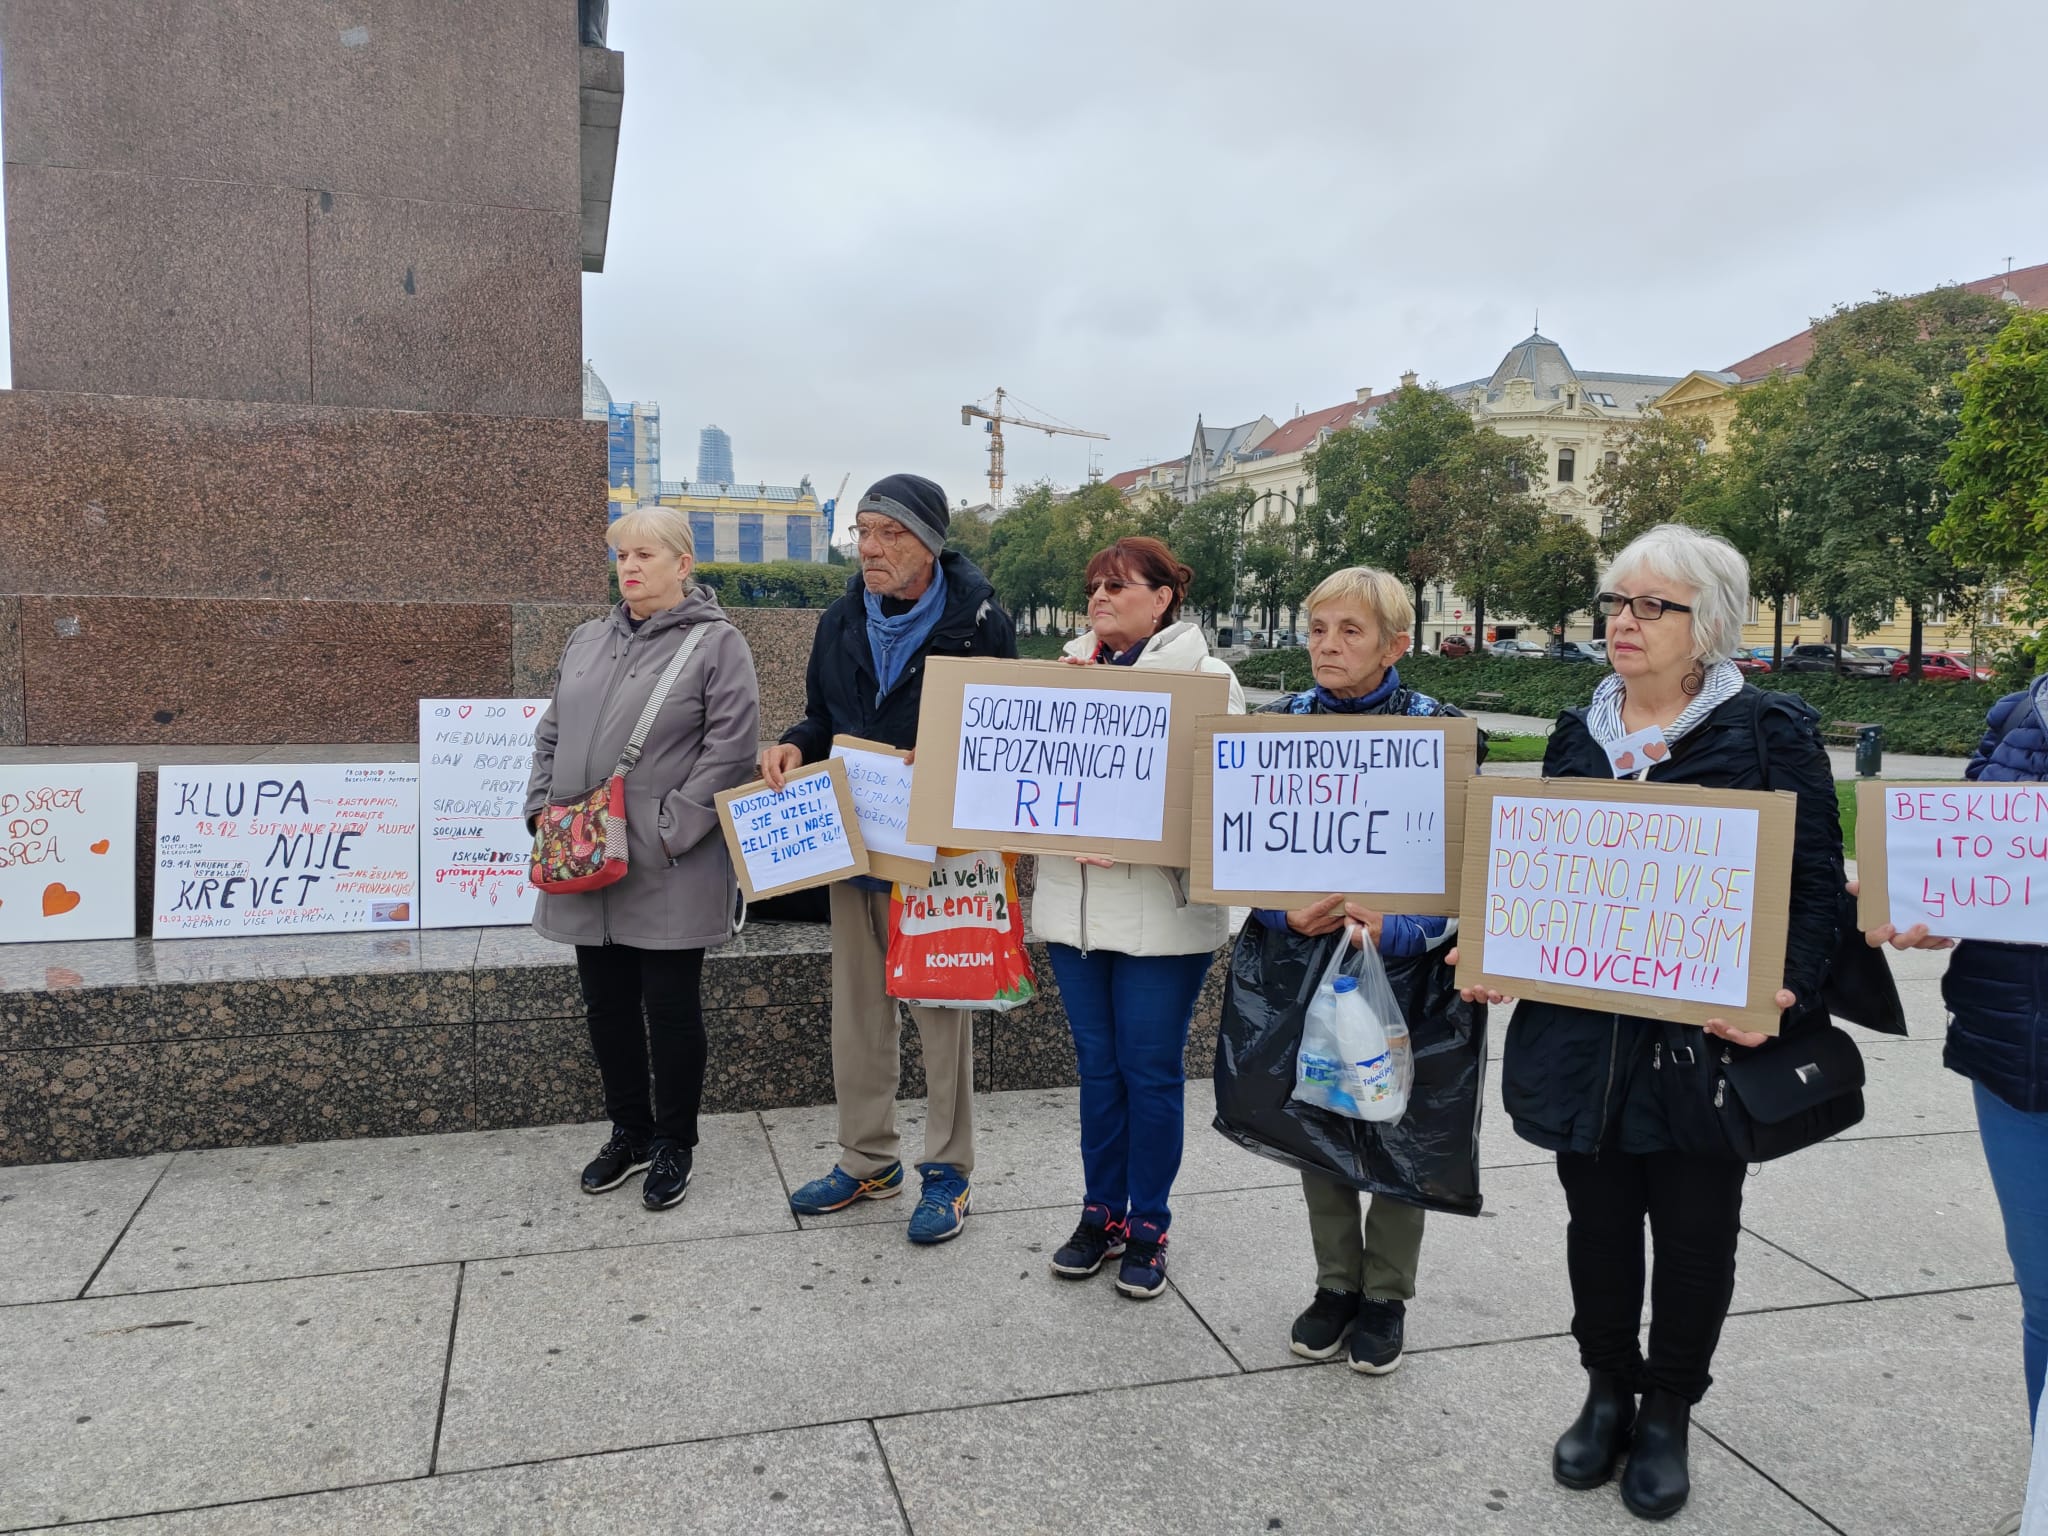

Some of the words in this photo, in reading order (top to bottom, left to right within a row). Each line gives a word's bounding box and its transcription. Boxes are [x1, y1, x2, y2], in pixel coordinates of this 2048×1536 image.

[484, 705, 506, 719] DO
[964, 696, 1078, 735] SOCIJALNA
[1083, 702, 1168, 739] PRAVDA
[961, 736, 1127, 781] NEPOZNANICA
[1135, 746, 1154, 781] U
[1217, 740, 1246, 769] EU
[433, 795, 525, 817] SIROMAŠT
[732, 775, 831, 820] DOSTOJANSTVO
[8, 818, 49, 839] DO
[751, 812, 773, 831] STE
[795, 823, 801, 836] I
[804, 813, 834, 833] NAŠE
[1222, 811, 1253, 853] MI
[1264, 809, 1390, 855] SLUGE
[1498, 805, 1524, 840] MI
[1528, 806, 1582, 846] SMO
[1585, 809, 1723, 857] ODRADILI
[264, 831, 363, 870] NIJE
[1936, 837, 1943, 859] I
[1951, 834, 1993, 859] TO
[2006, 834, 2048, 861] SU
[1636, 861, 1660, 903] A
[276, 913, 335, 925] VREMENA
[994, 892, 1007, 920] 2
[1486, 894, 1640, 952] BOGATITE
[1643, 907, 1747, 969] NAŠIM
[925, 951, 994, 968] KONZUM
[1539, 944, 1684, 991] NOVCEM
